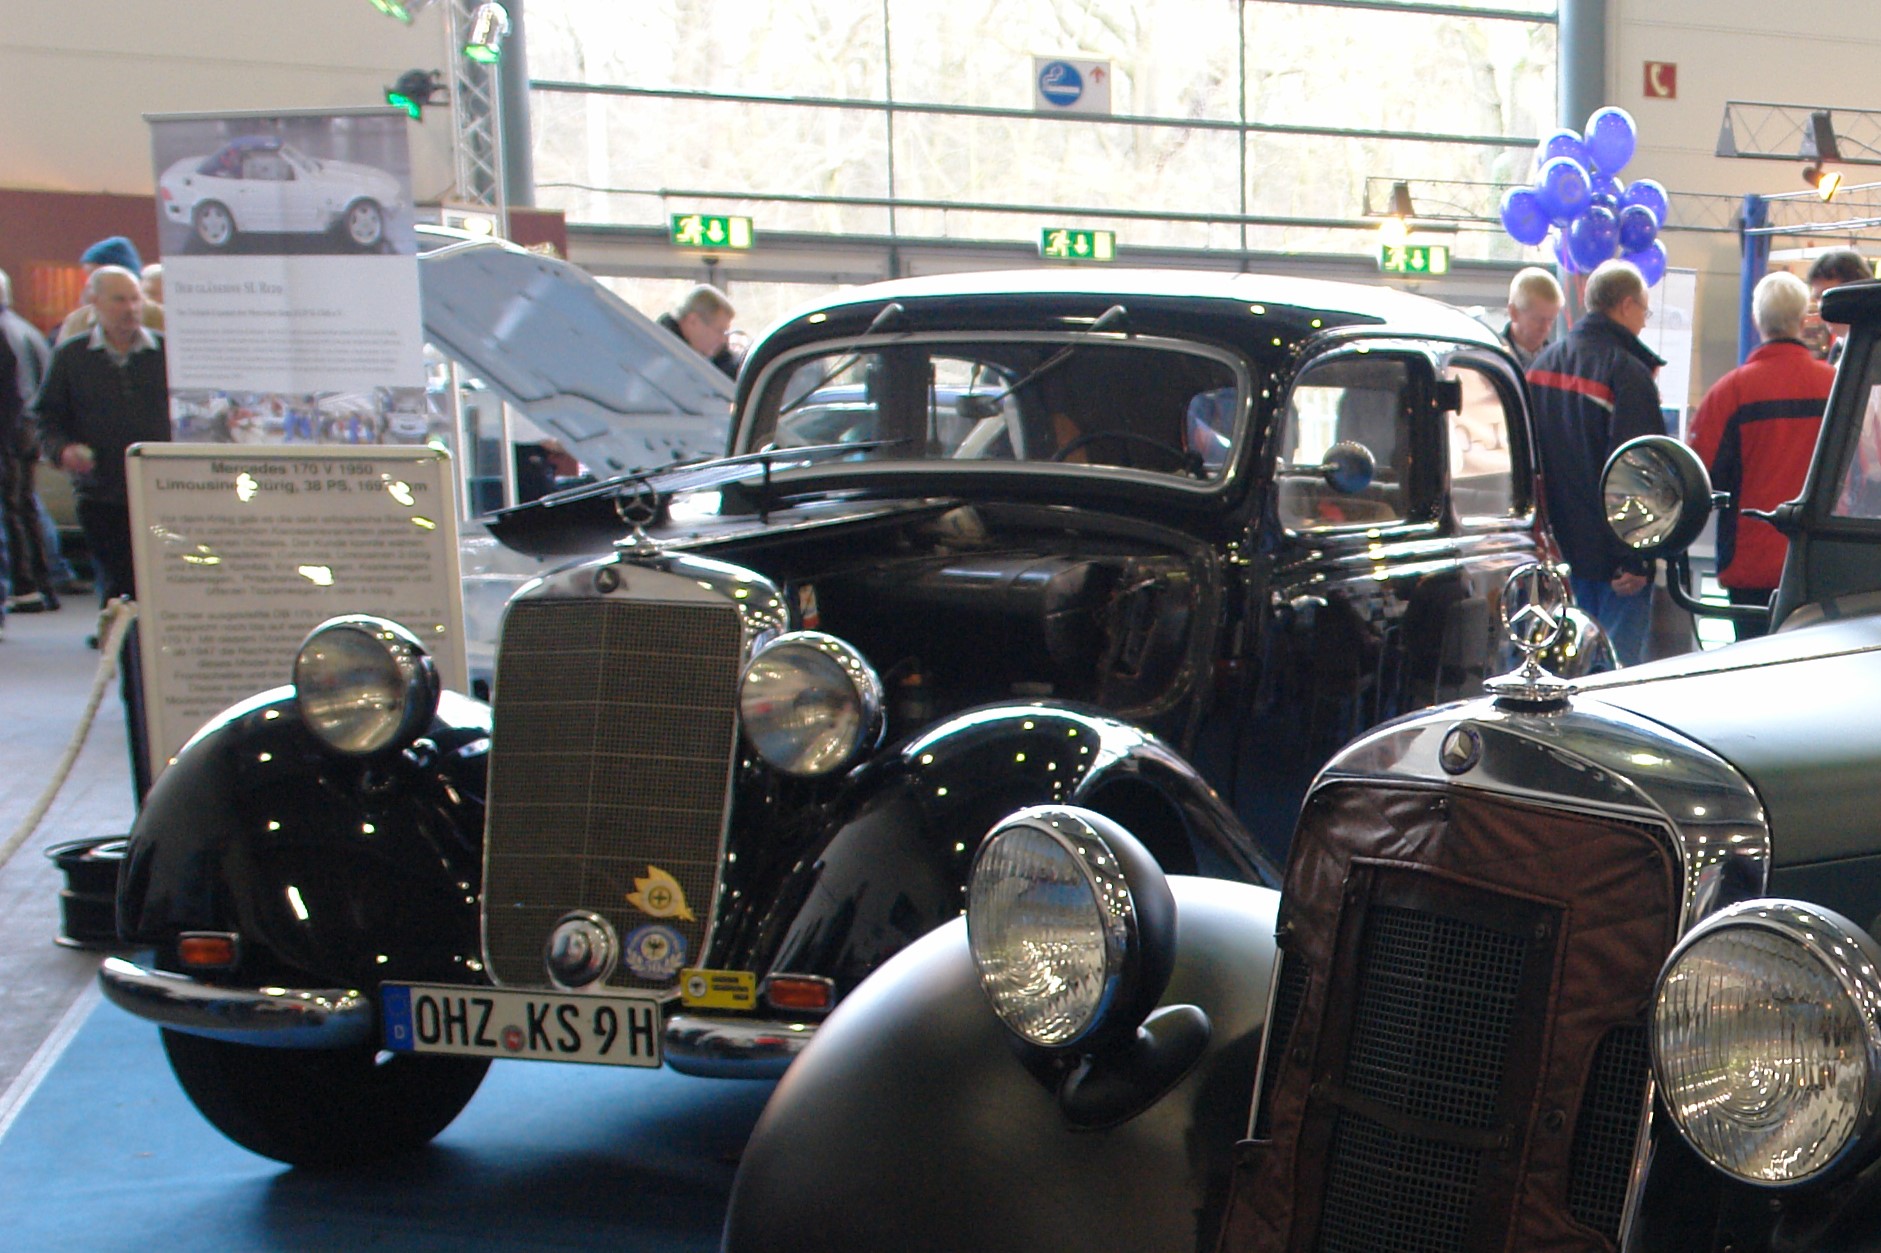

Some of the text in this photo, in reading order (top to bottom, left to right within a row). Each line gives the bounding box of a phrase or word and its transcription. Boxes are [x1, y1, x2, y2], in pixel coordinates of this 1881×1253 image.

[211, 462, 374, 475] Mercedes 170 V 1950
[303, 481, 321, 493] 38
[415, 994, 497, 1048] OHZ
[526, 1001, 581, 1053] KS
[394, 1025, 405, 1040] D
